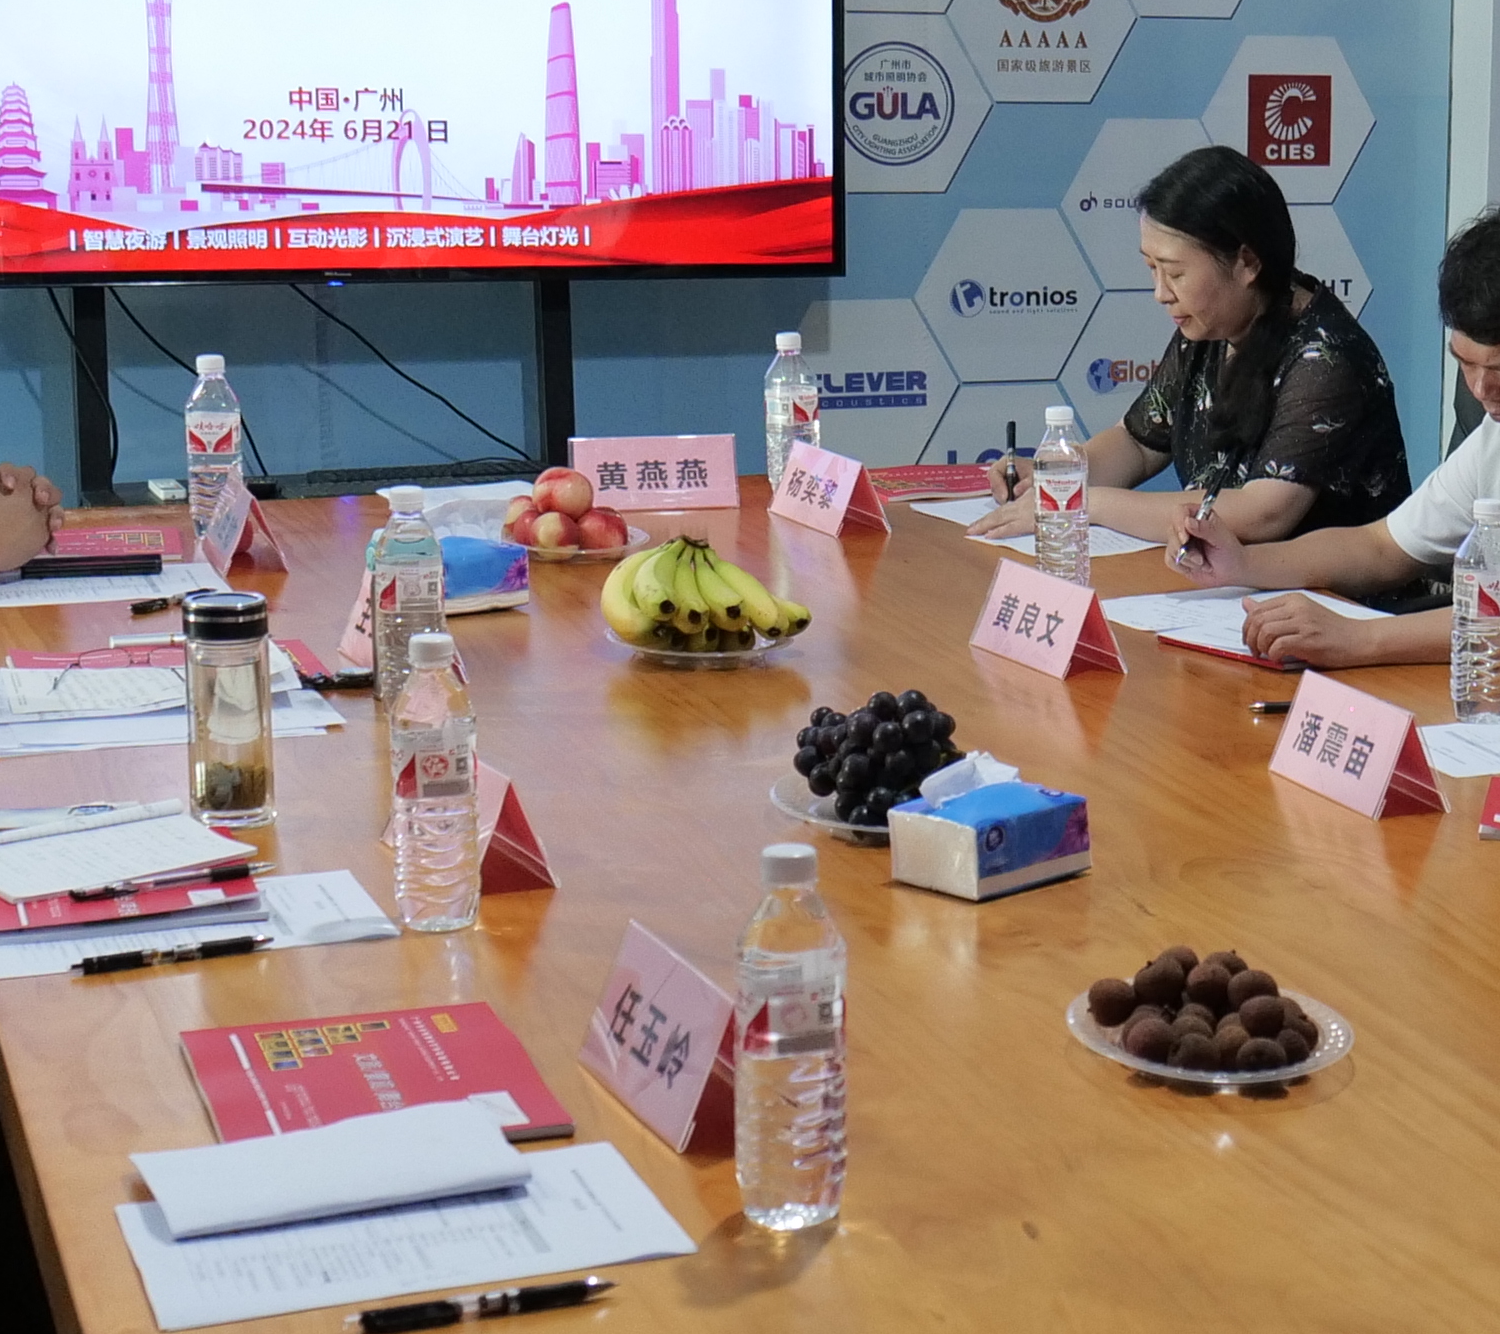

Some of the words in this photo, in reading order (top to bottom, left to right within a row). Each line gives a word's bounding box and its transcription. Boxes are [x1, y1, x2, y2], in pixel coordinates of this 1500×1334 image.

[849, 91, 941, 121] GULA
[243, 118, 334, 142] 2024年
[1265, 143, 1317, 161] CIES
[84, 229, 168, 251] 智慧夜游
[186, 228, 268, 250] 景观照明
[287, 227, 368, 249] 互动光影
[386, 226, 484, 248] 沉浸式演艺
[502, 225, 579, 247] 舞台灯光
[989, 286, 1078, 308] tronios
[821, 397, 923, 407] coustics
[596, 458, 709, 492] 黄燕燕
[991, 593, 1065, 648] 黄良文
[1292, 708, 1376, 782] 潘震宙
